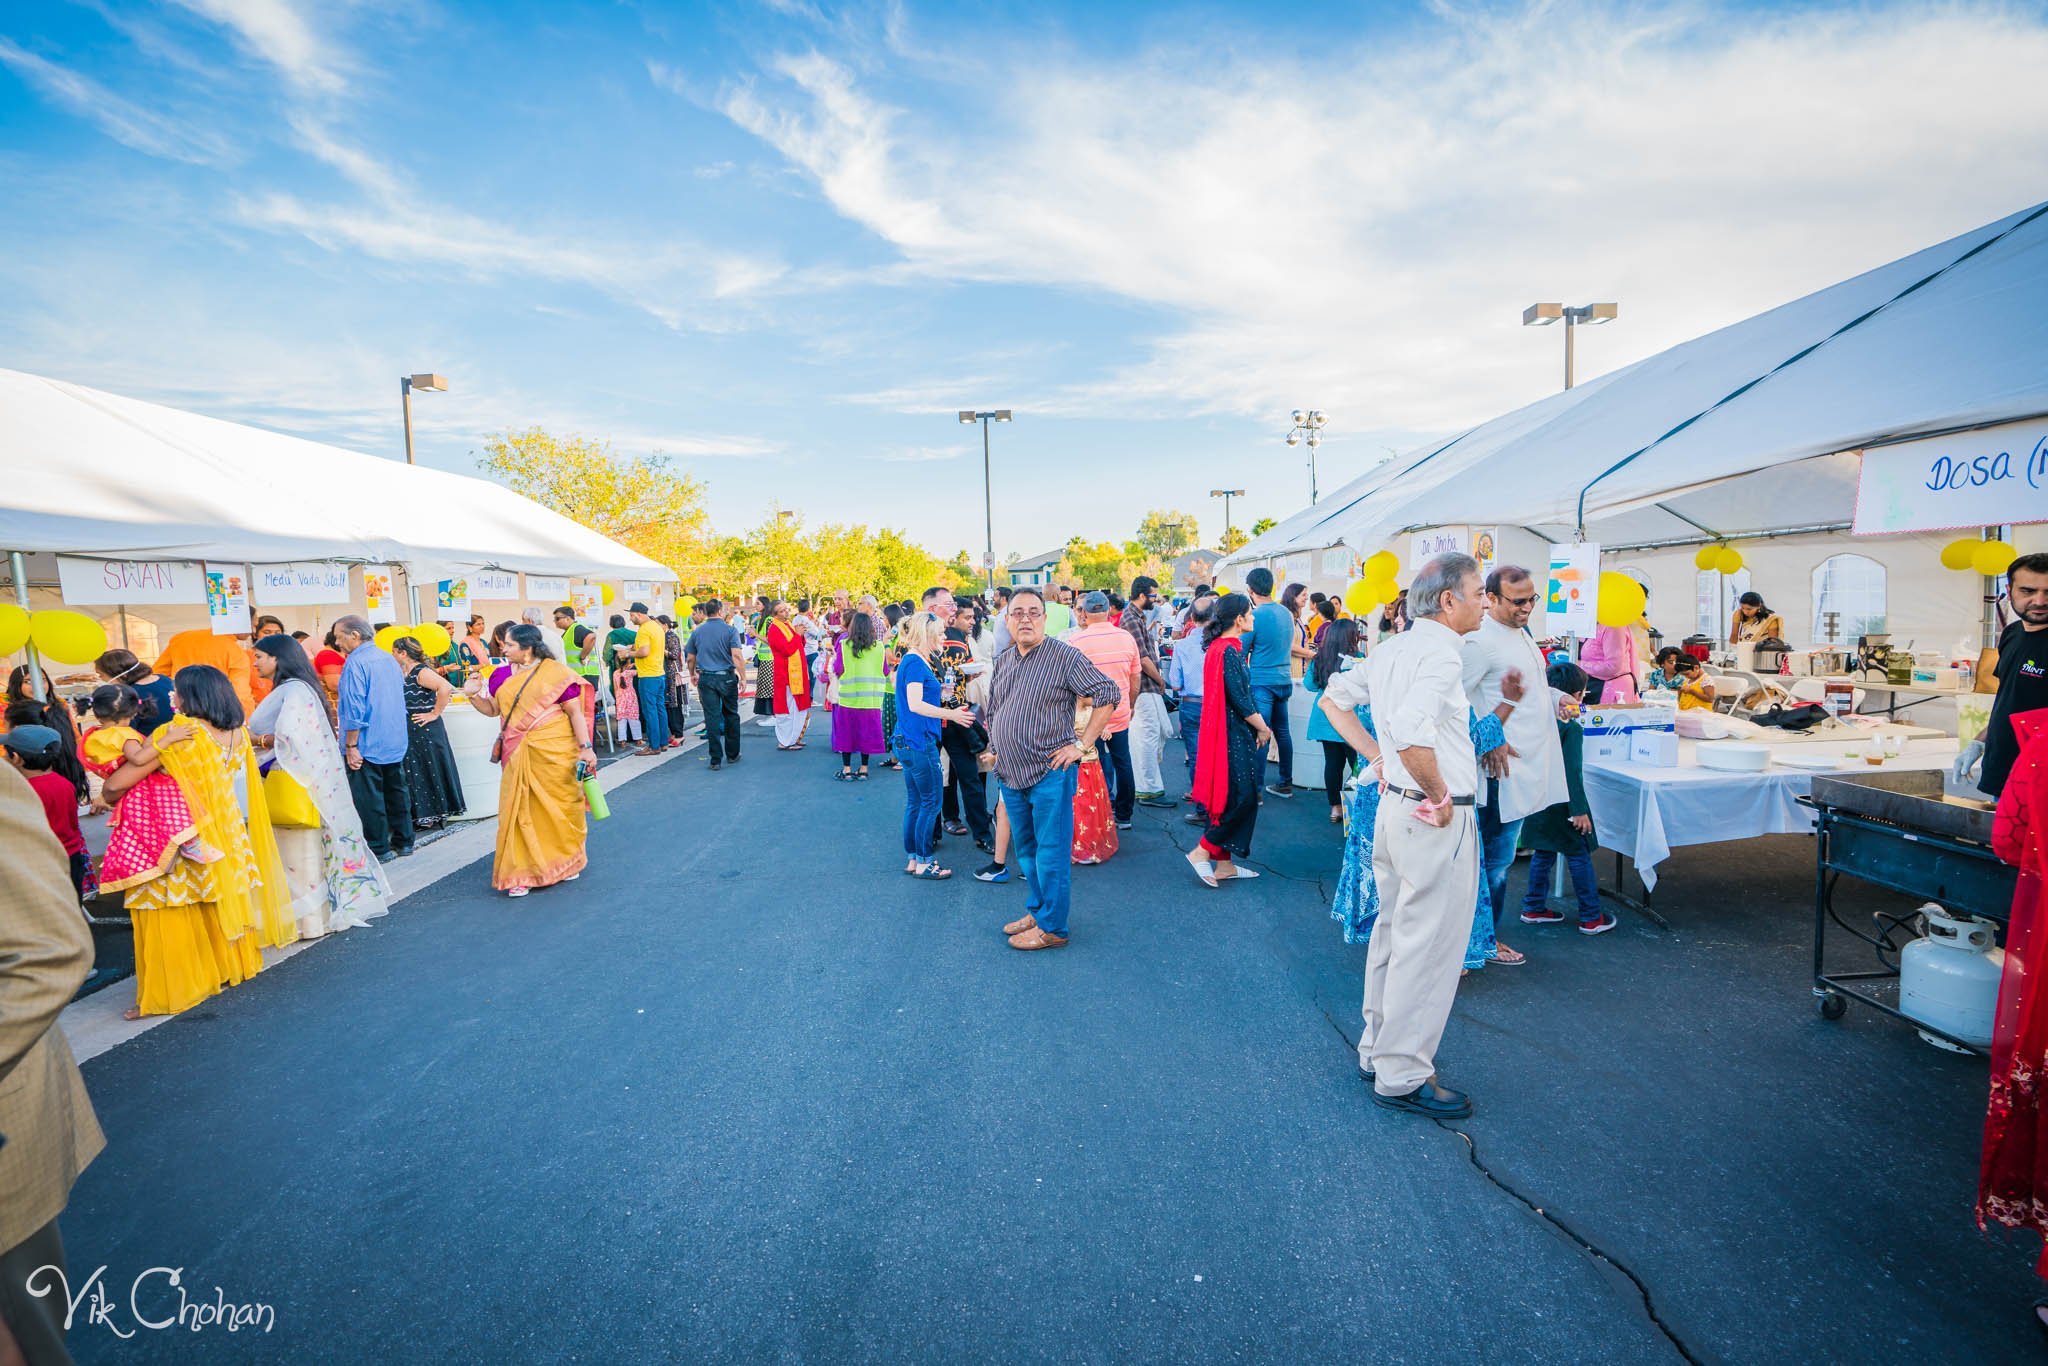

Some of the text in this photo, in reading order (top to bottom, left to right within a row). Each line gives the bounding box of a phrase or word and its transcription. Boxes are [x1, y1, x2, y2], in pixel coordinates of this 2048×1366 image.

[103, 561, 174, 590] SWAN
[265, 571, 346, 588] Medu Vada Stall
